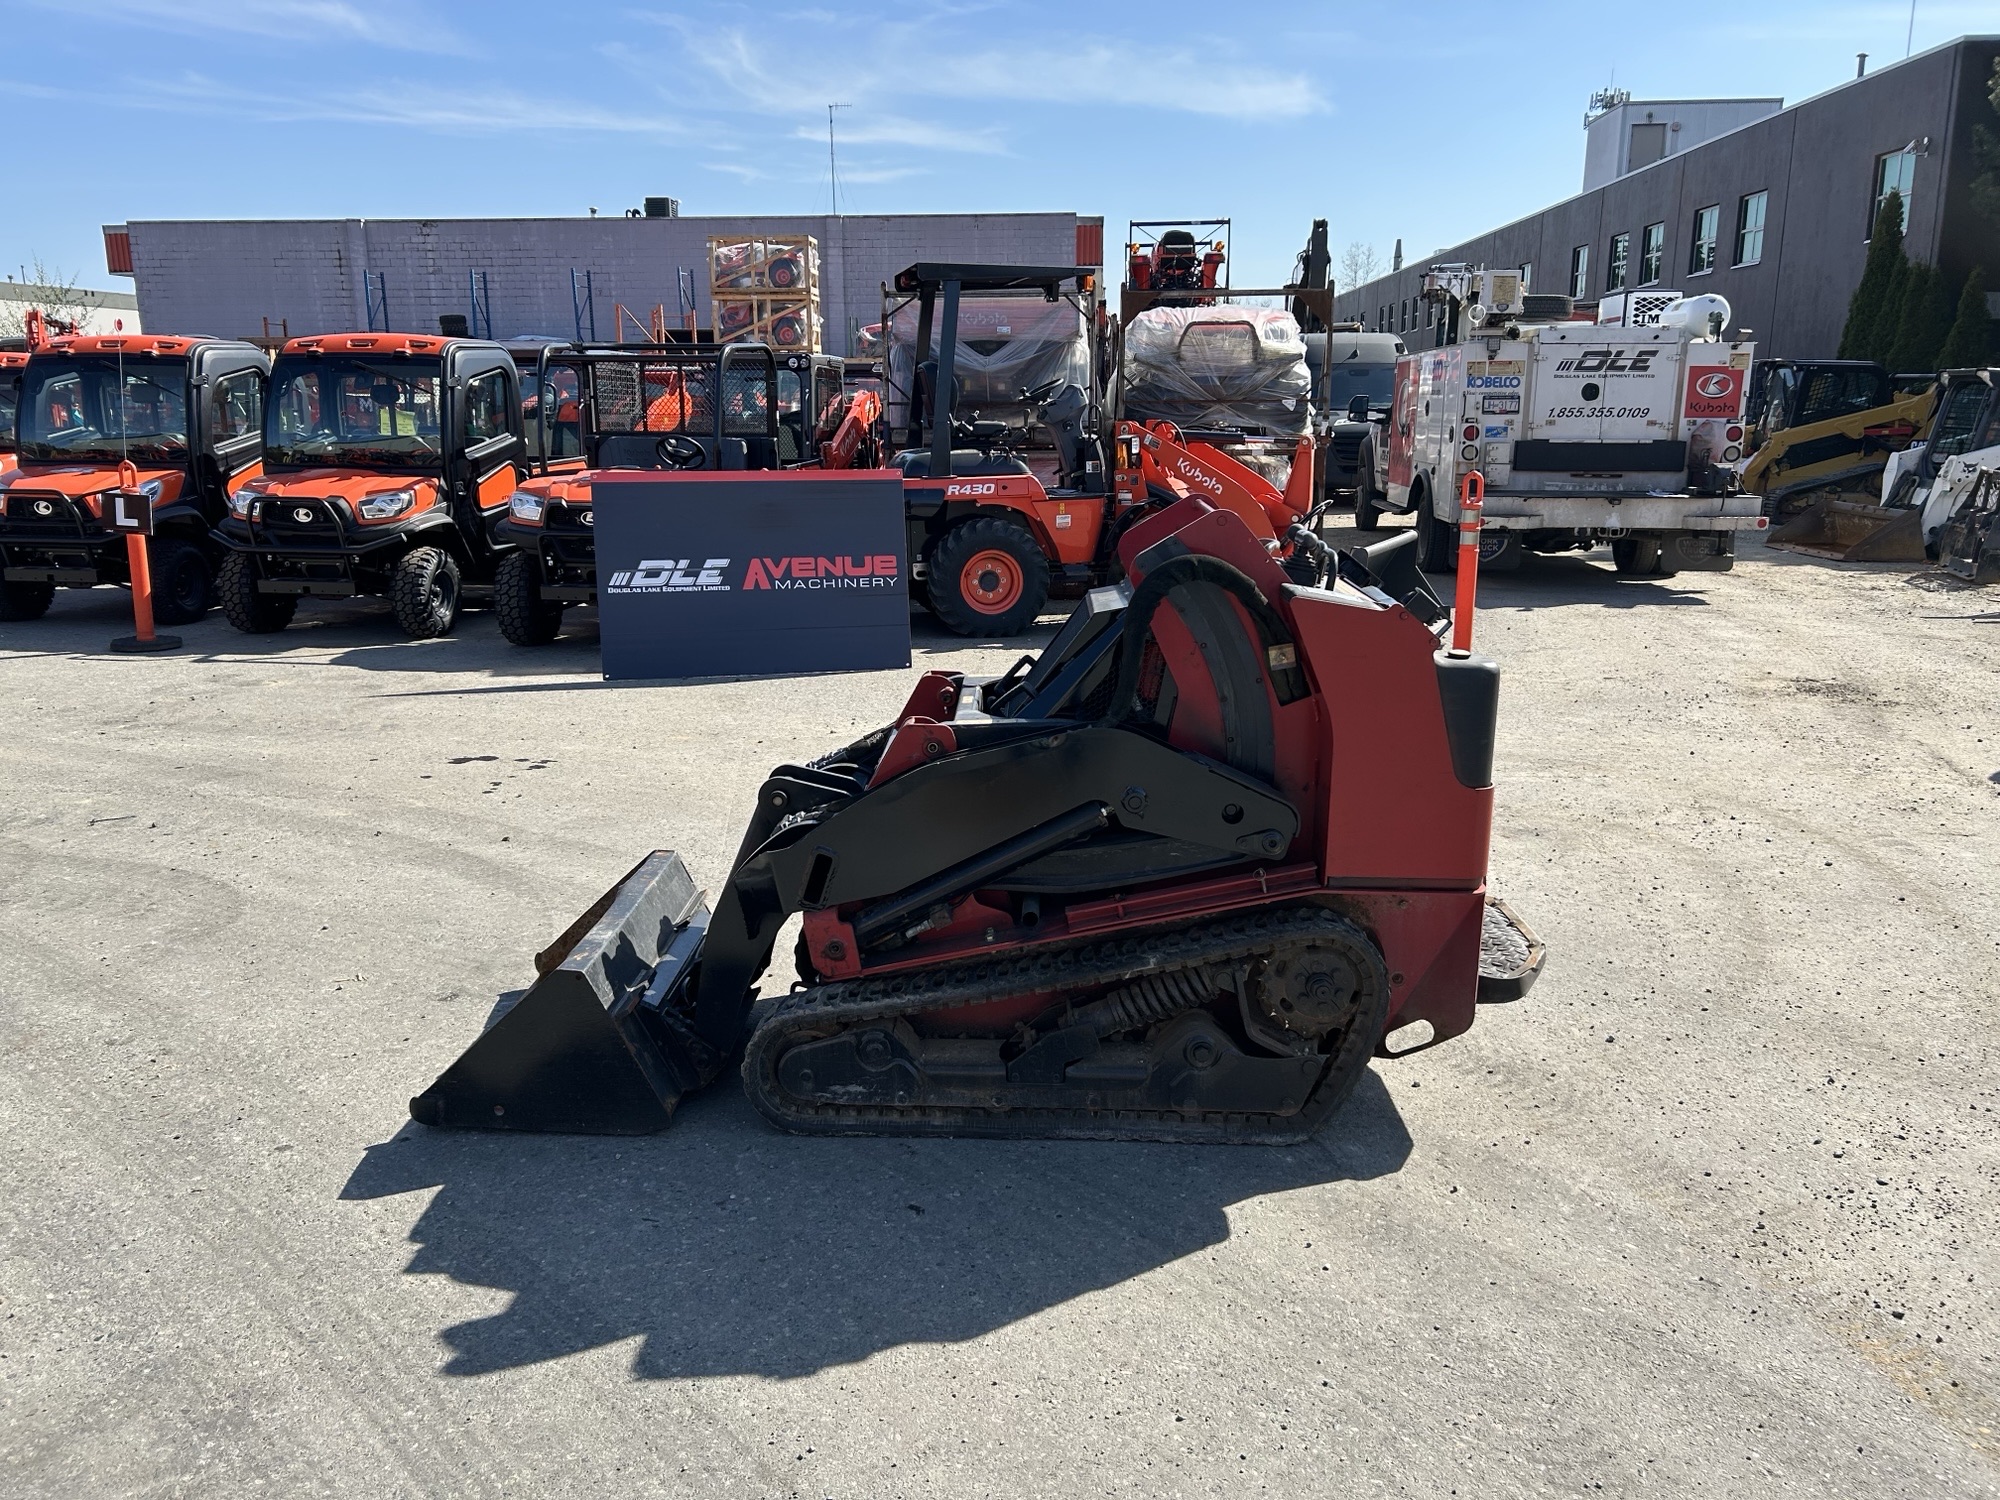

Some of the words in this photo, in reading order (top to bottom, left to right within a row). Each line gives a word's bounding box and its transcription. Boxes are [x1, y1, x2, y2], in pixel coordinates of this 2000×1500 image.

[960, 312, 1008, 325] Kubota
[1572, 350, 1659, 372] DLE
[1466, 376, 1521, 388] KOBELCO
[1548, 407, 1650, 418] 1.855.355.0109
[1690, 402, 1735, 413] Kubota
[1177, 457, 1223, 495] Kubota
[947, 483, 996, 496] R430
[115, 497, 139, 526] L
[629, 558, 731, 587] DLE
[743, 555, 898, 590] AVENUE
[775, 577, 898, 590] MACHINERY
